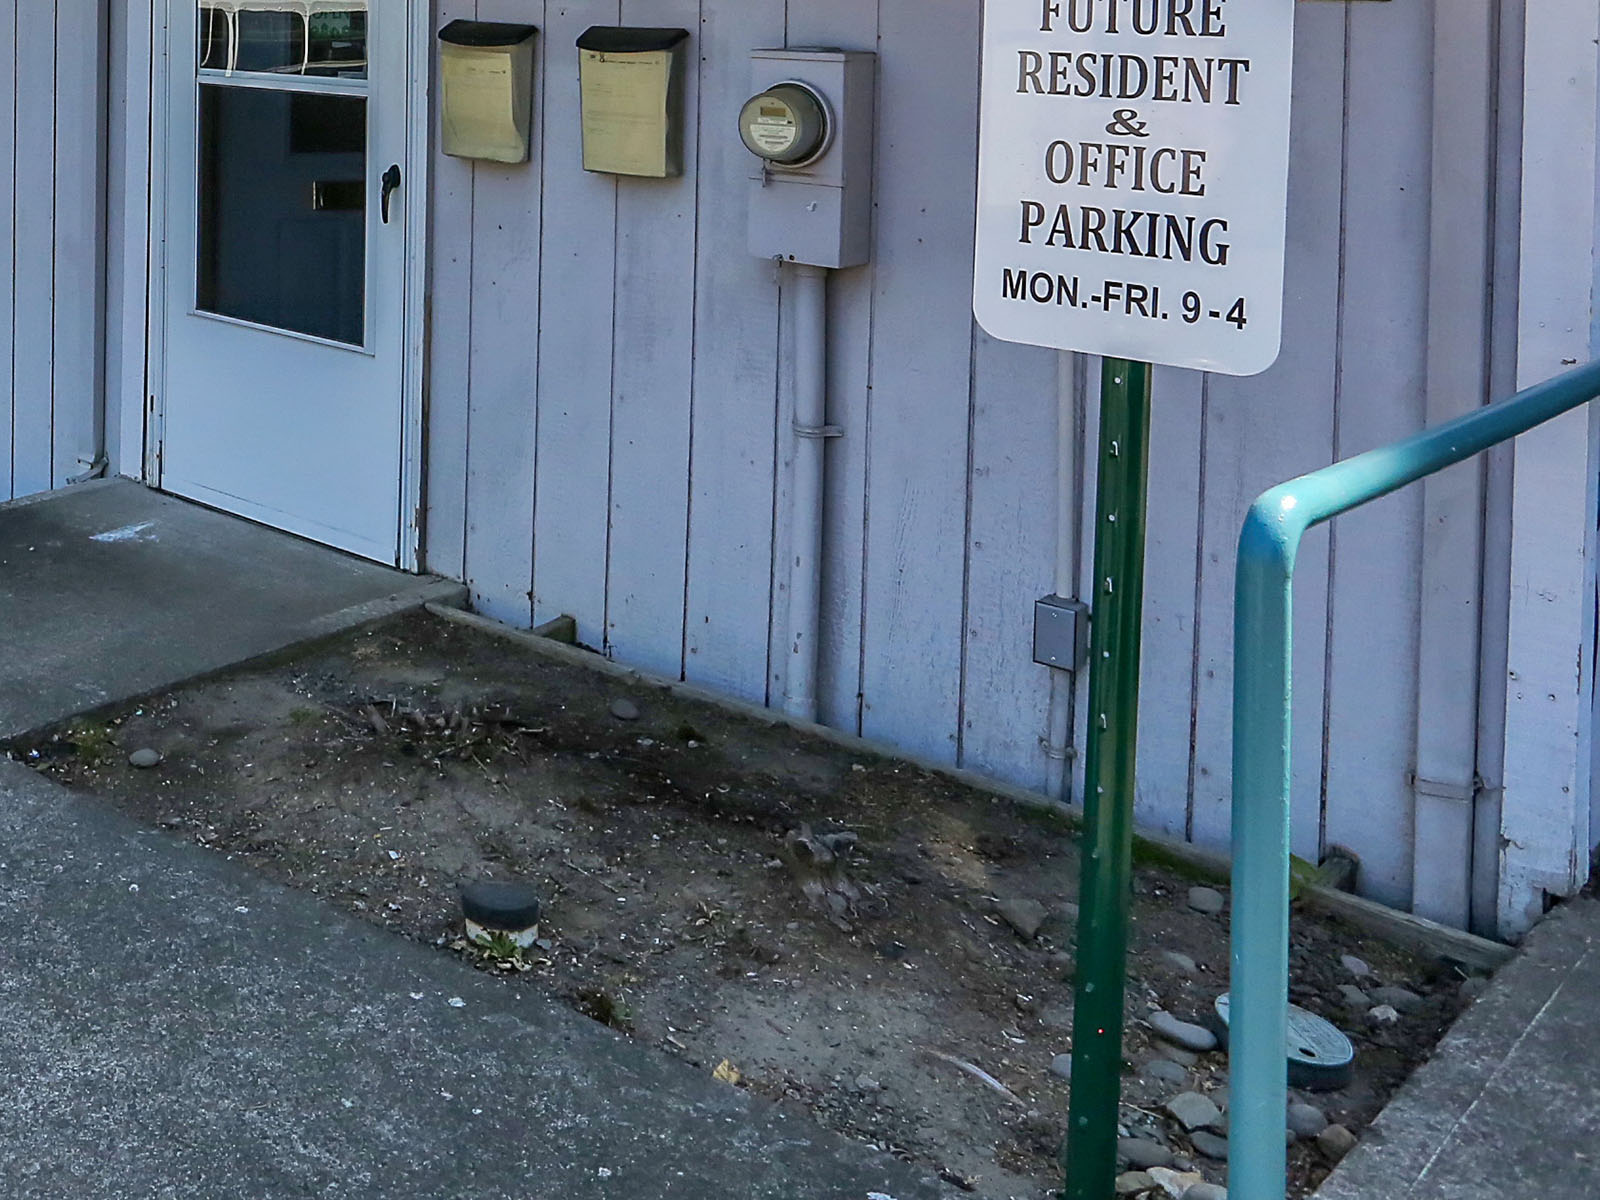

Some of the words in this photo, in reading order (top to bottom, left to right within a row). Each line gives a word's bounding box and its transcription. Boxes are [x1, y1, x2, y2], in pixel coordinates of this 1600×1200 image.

[1016, 50, 1250, 106] RESIDENT
[1105, 108, 1150, 138] &
[1045, 140, 1207, 197] OFFICE
[1018, 200, 1230, 266] PARKING
[1001, 268, 1169, 320] MON.-FRI.
[1181, 291, 1247, 330] 9-4
